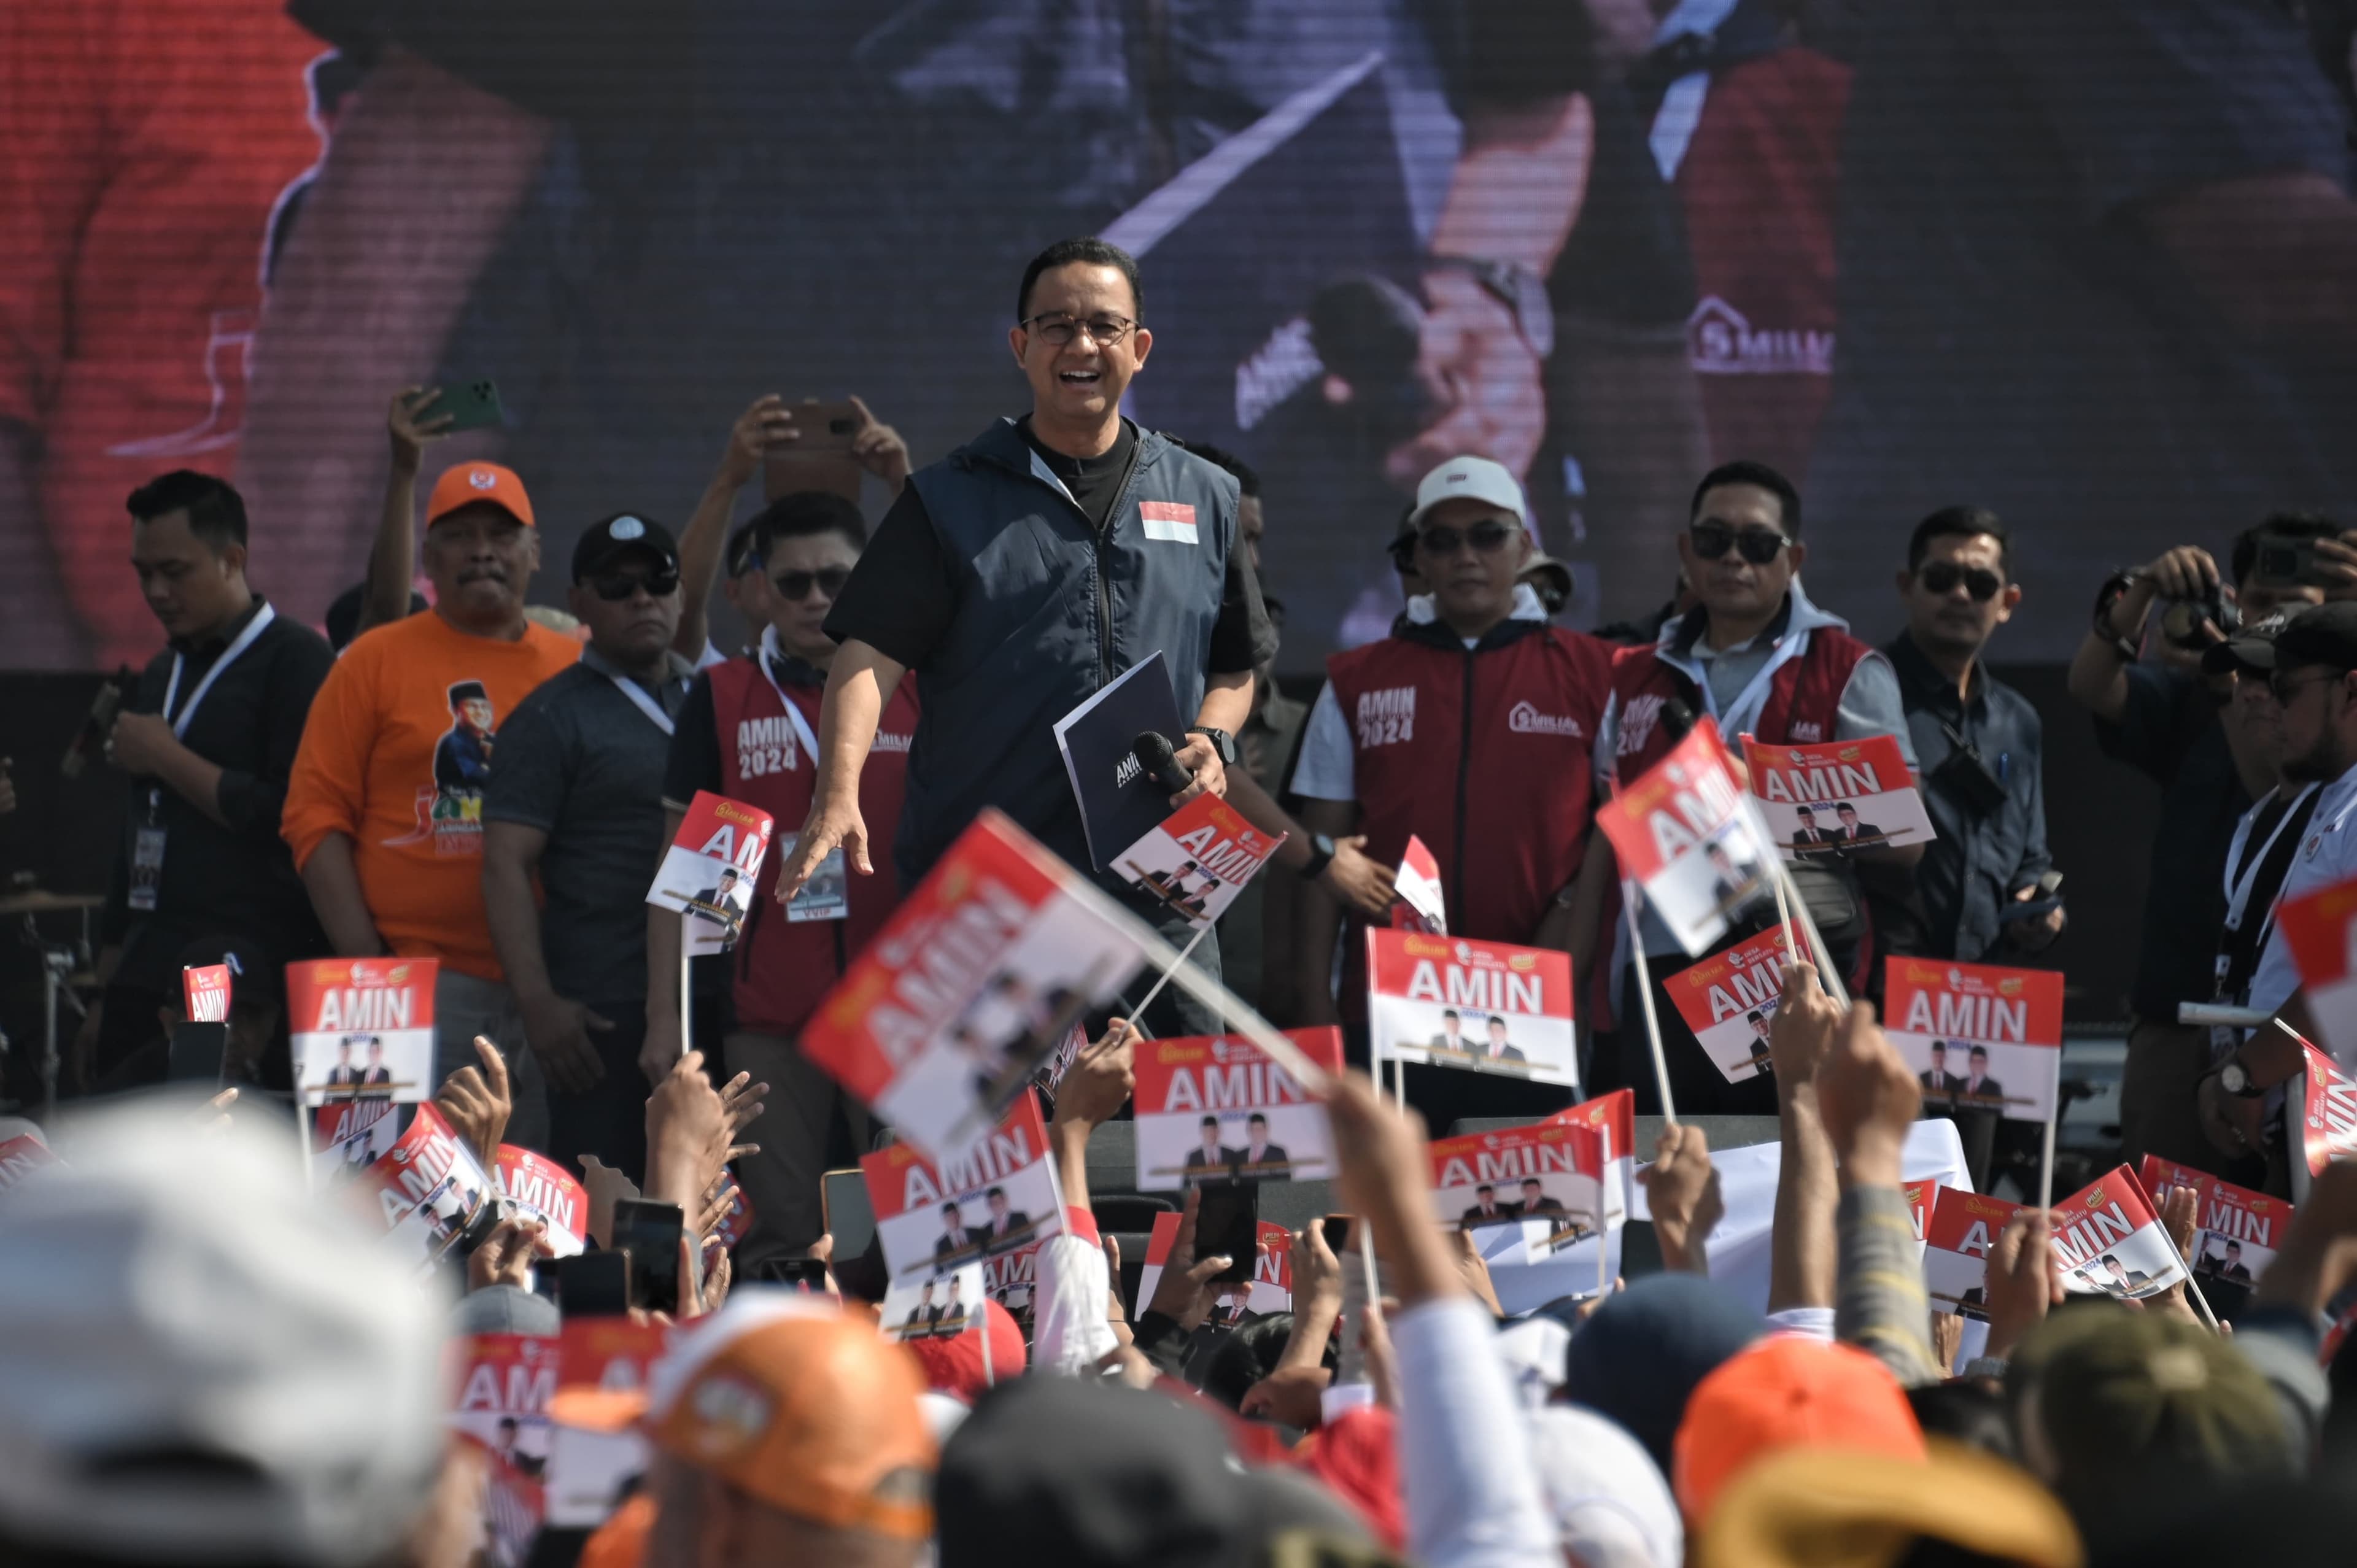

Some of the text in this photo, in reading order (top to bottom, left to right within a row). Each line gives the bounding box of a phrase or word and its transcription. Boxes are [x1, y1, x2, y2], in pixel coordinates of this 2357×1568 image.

[1357, 686, 1416, 719] AMIN
[738, 716, 797, 749] AMIN
[1358, 719, 1414, 749] 2024
[738, 748, 797, 780] 2024
[1767, 761, 1882, 803] AMIN
[699, 824, 766, 879] AM
[1177, 825, 1261, 886] AMIN
[191, 988, 226, 1022] AMIN
[315, 987, 412, 1032] AMIN
[1406, 959, 1543, 1015] AMIN
[1906, 989, 2027, 1042] AMIN
[1164, 1060, 1305, 1111] AMIN
[379, 1124, 455, 1228] AMIN
[903, 1124, 1032, 1212] AMIN
[1439, 1142, 1576, 1188] AMIN
[2081, 1257, 2102, 1272] 2024
